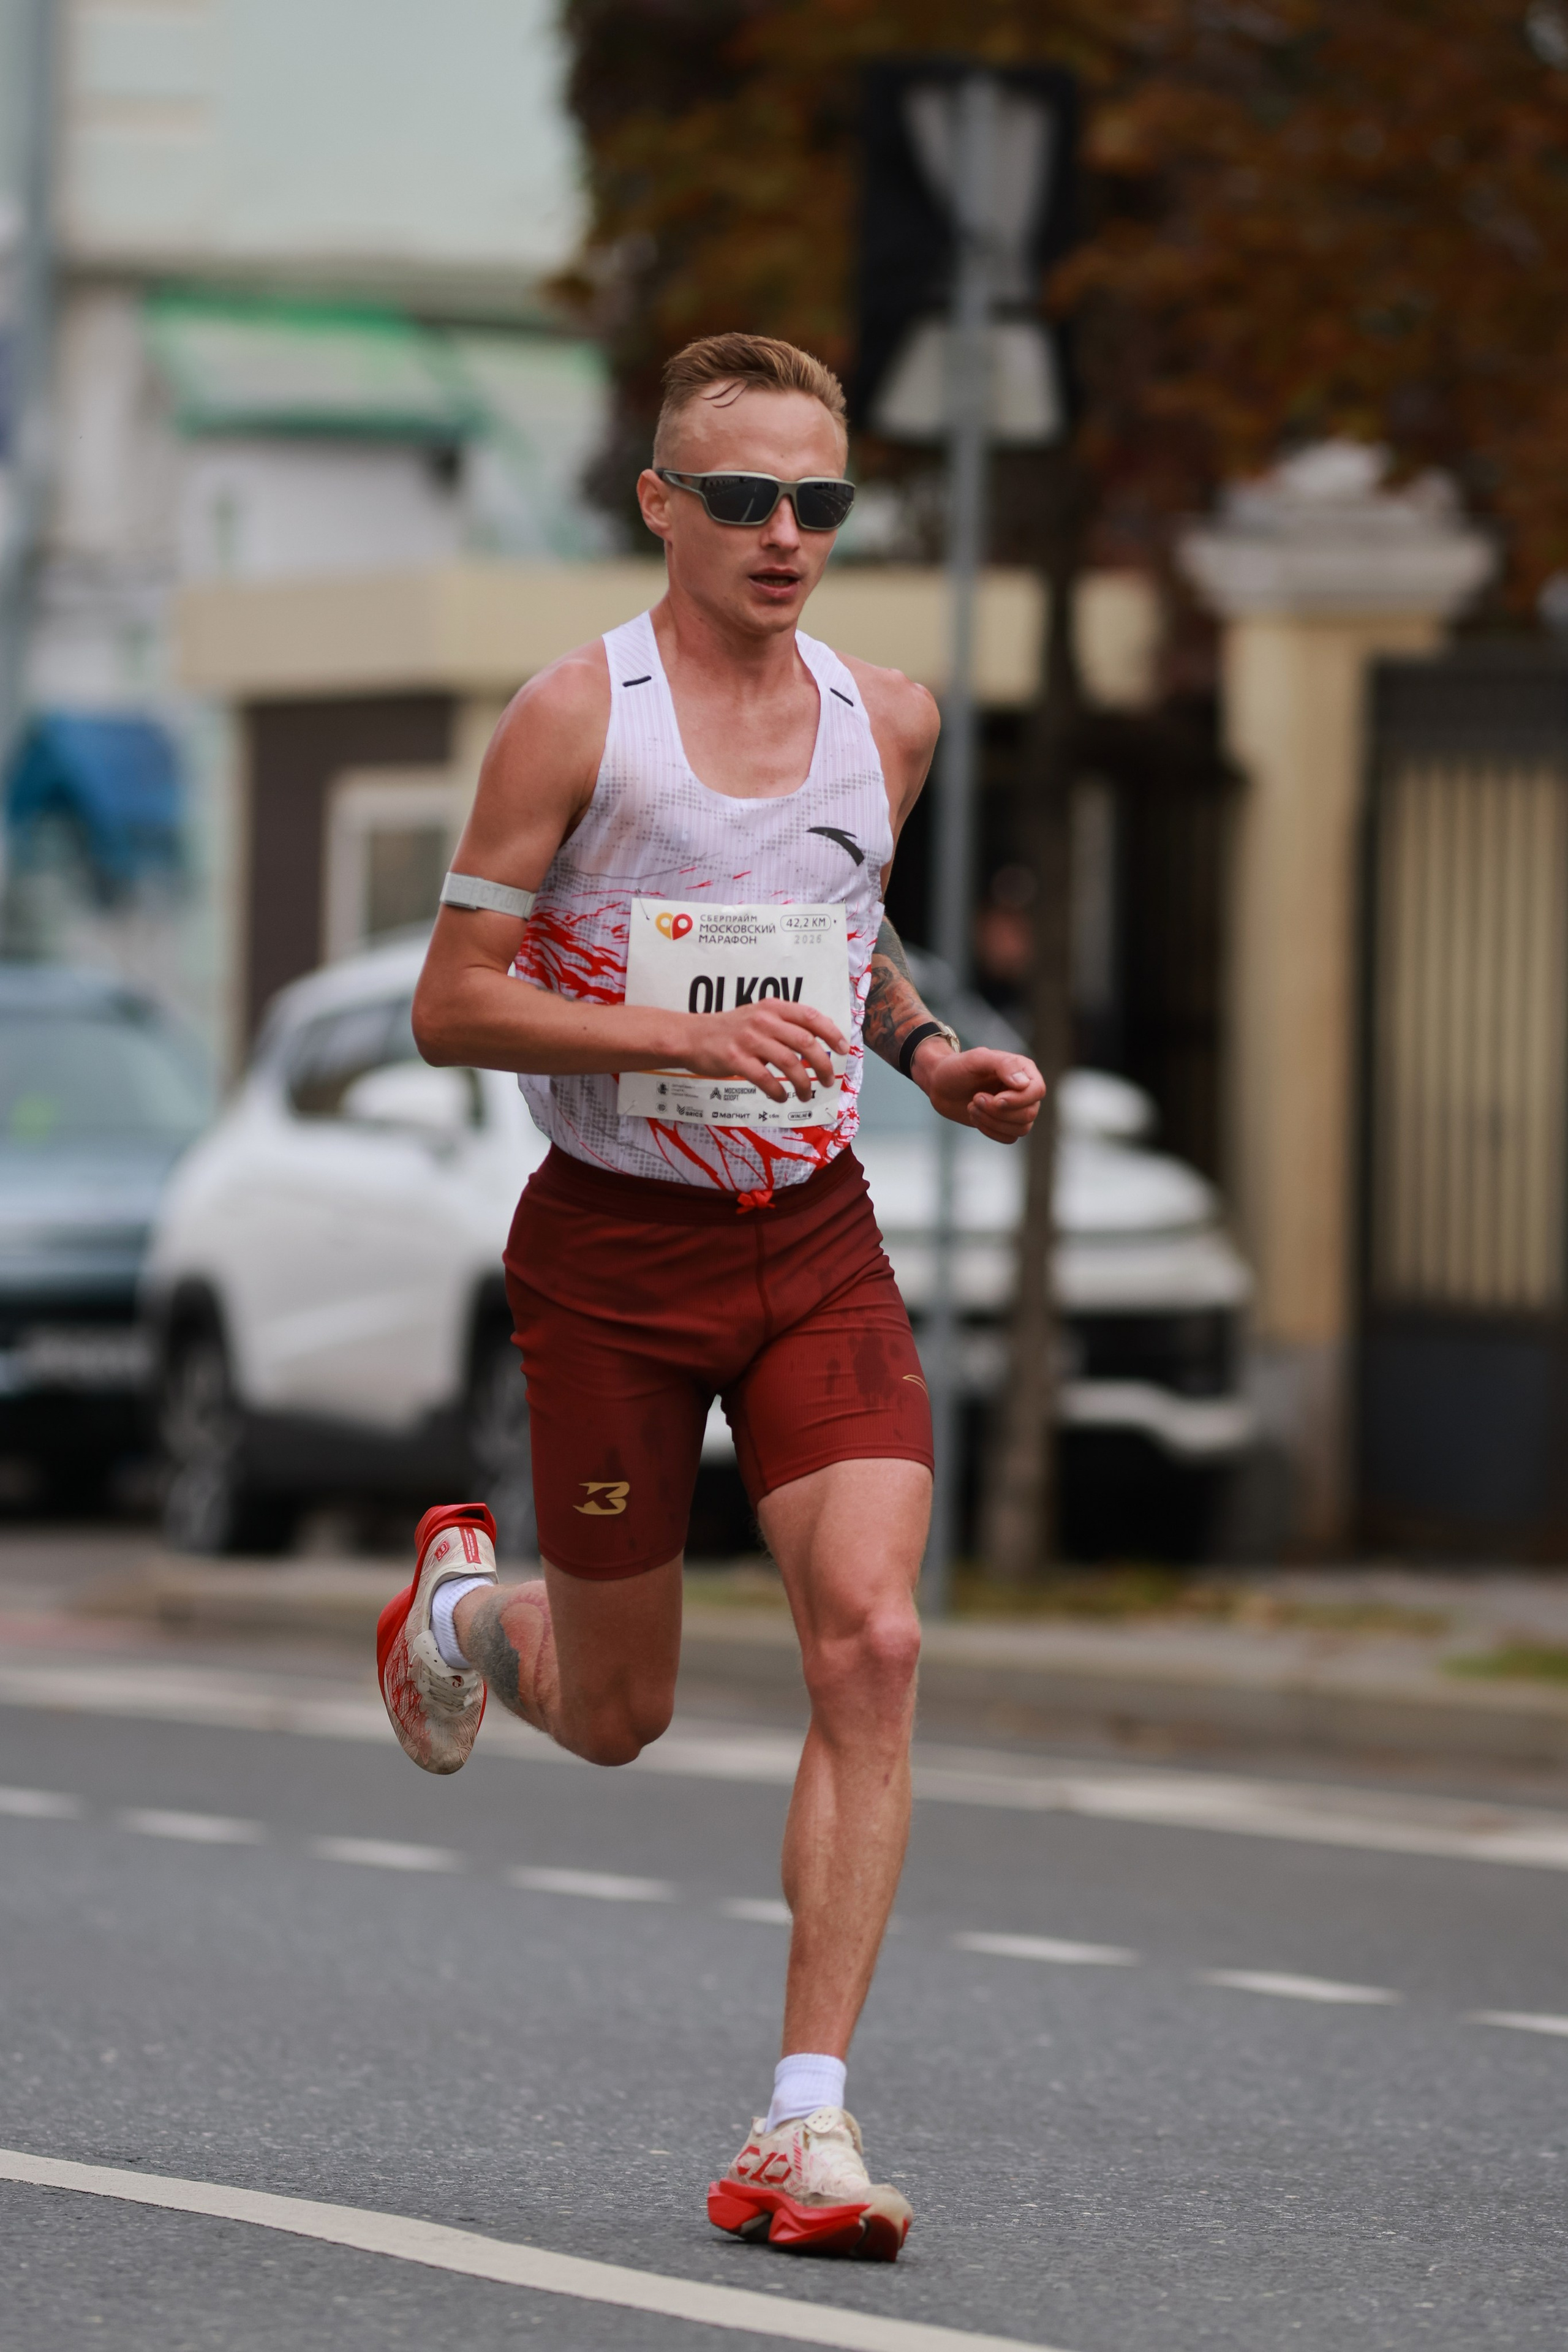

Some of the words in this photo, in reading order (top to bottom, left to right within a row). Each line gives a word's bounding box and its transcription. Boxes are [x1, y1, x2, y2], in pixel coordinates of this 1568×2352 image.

[700, 913, 757, 922] СБЕРПРАЙМ
[699, 923, 776, 933] МОСКОВСКИЙ
[786, 918, 809, 929] 42,2
[698, 935, 757, 944] МАРАФОН
